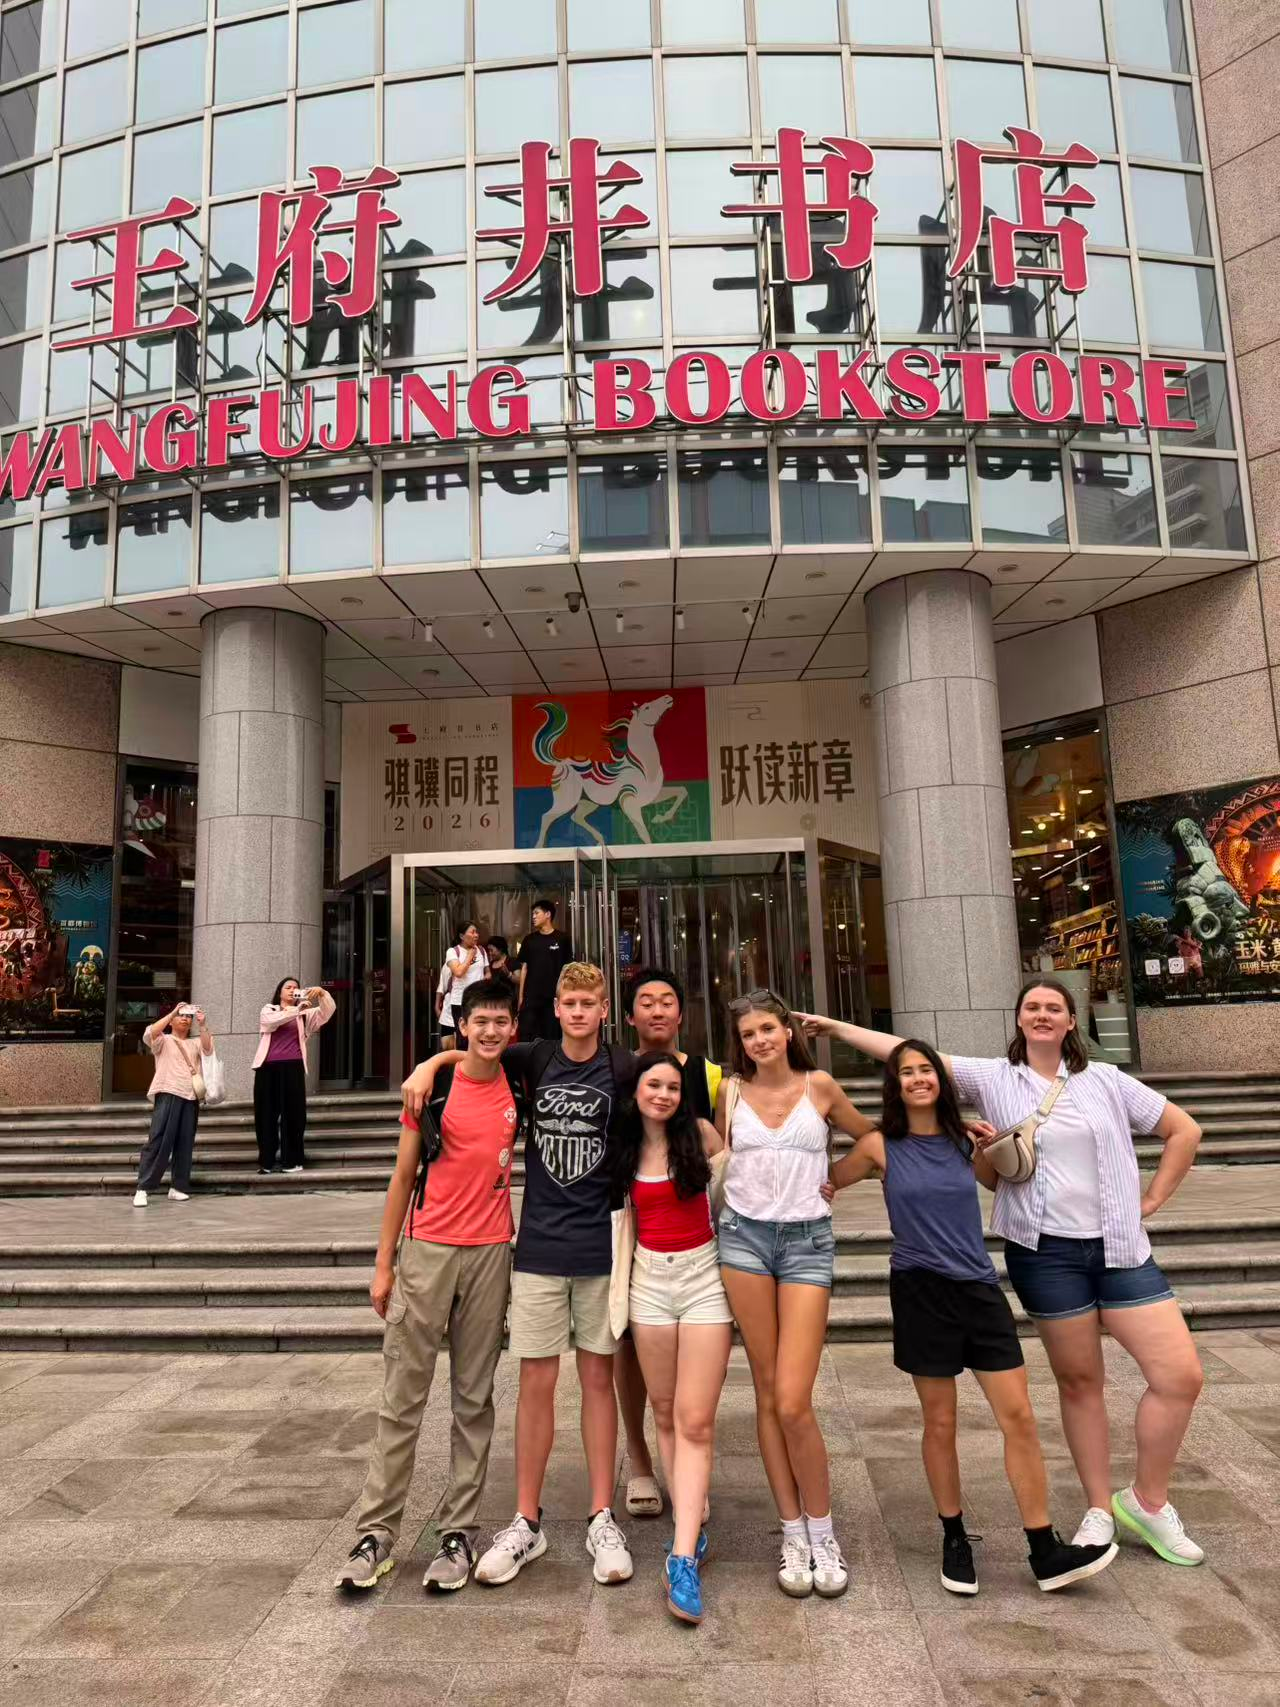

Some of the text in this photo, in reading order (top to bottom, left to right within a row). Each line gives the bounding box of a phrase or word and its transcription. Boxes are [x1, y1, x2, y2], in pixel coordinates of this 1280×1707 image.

[51, 126, 1099, 350] 王府井书店
[0, 348, 1198, 500] WANGFUJING BOOKSTORE
[384, 755, 499, 808] 骐骥同程
[720, 738, 855, 806] 跃读新章
[536, 1088, 602, 1117] Ford
[535, 1129, 602, 1180] MOTORS
